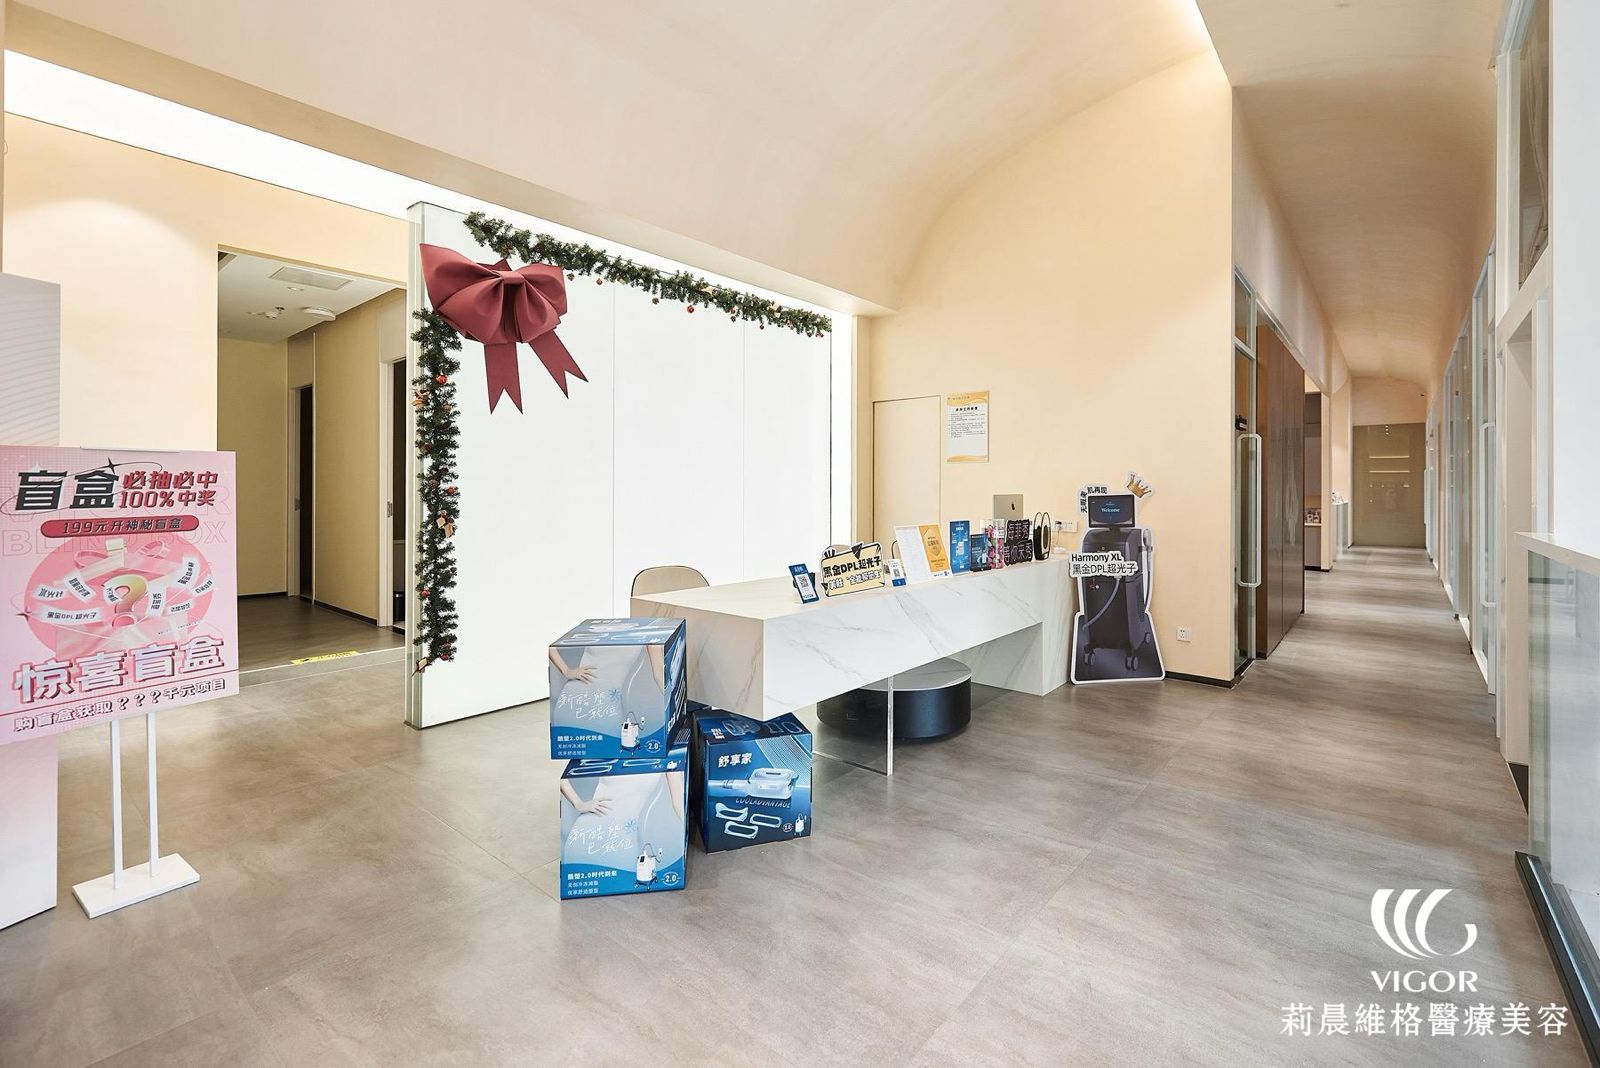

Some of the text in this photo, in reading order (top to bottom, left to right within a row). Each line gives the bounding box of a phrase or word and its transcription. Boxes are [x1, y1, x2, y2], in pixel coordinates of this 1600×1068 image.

[15, 469, 218, 512] 盲盒 必抽必中
[119, 490, 216, 508] 100%中奖
[62, 517, 182, 534] 199元开神秘盲盒
[1072, 553, 1122, 563] Harmony XL
[823, 556, 882, 578] 黑金DPL超光子
[1072, 563, 1137, 574] 黑金DPL超光子
[47, 611, 97, 620] 黑金DPL超光子
[12, 636, 225, 704] 惊喜盲盒
[648, 742, 659, 750] 2.0
[718, 752, 752, 768] 舒享家
[665, 874, 677, 882] 2.0
